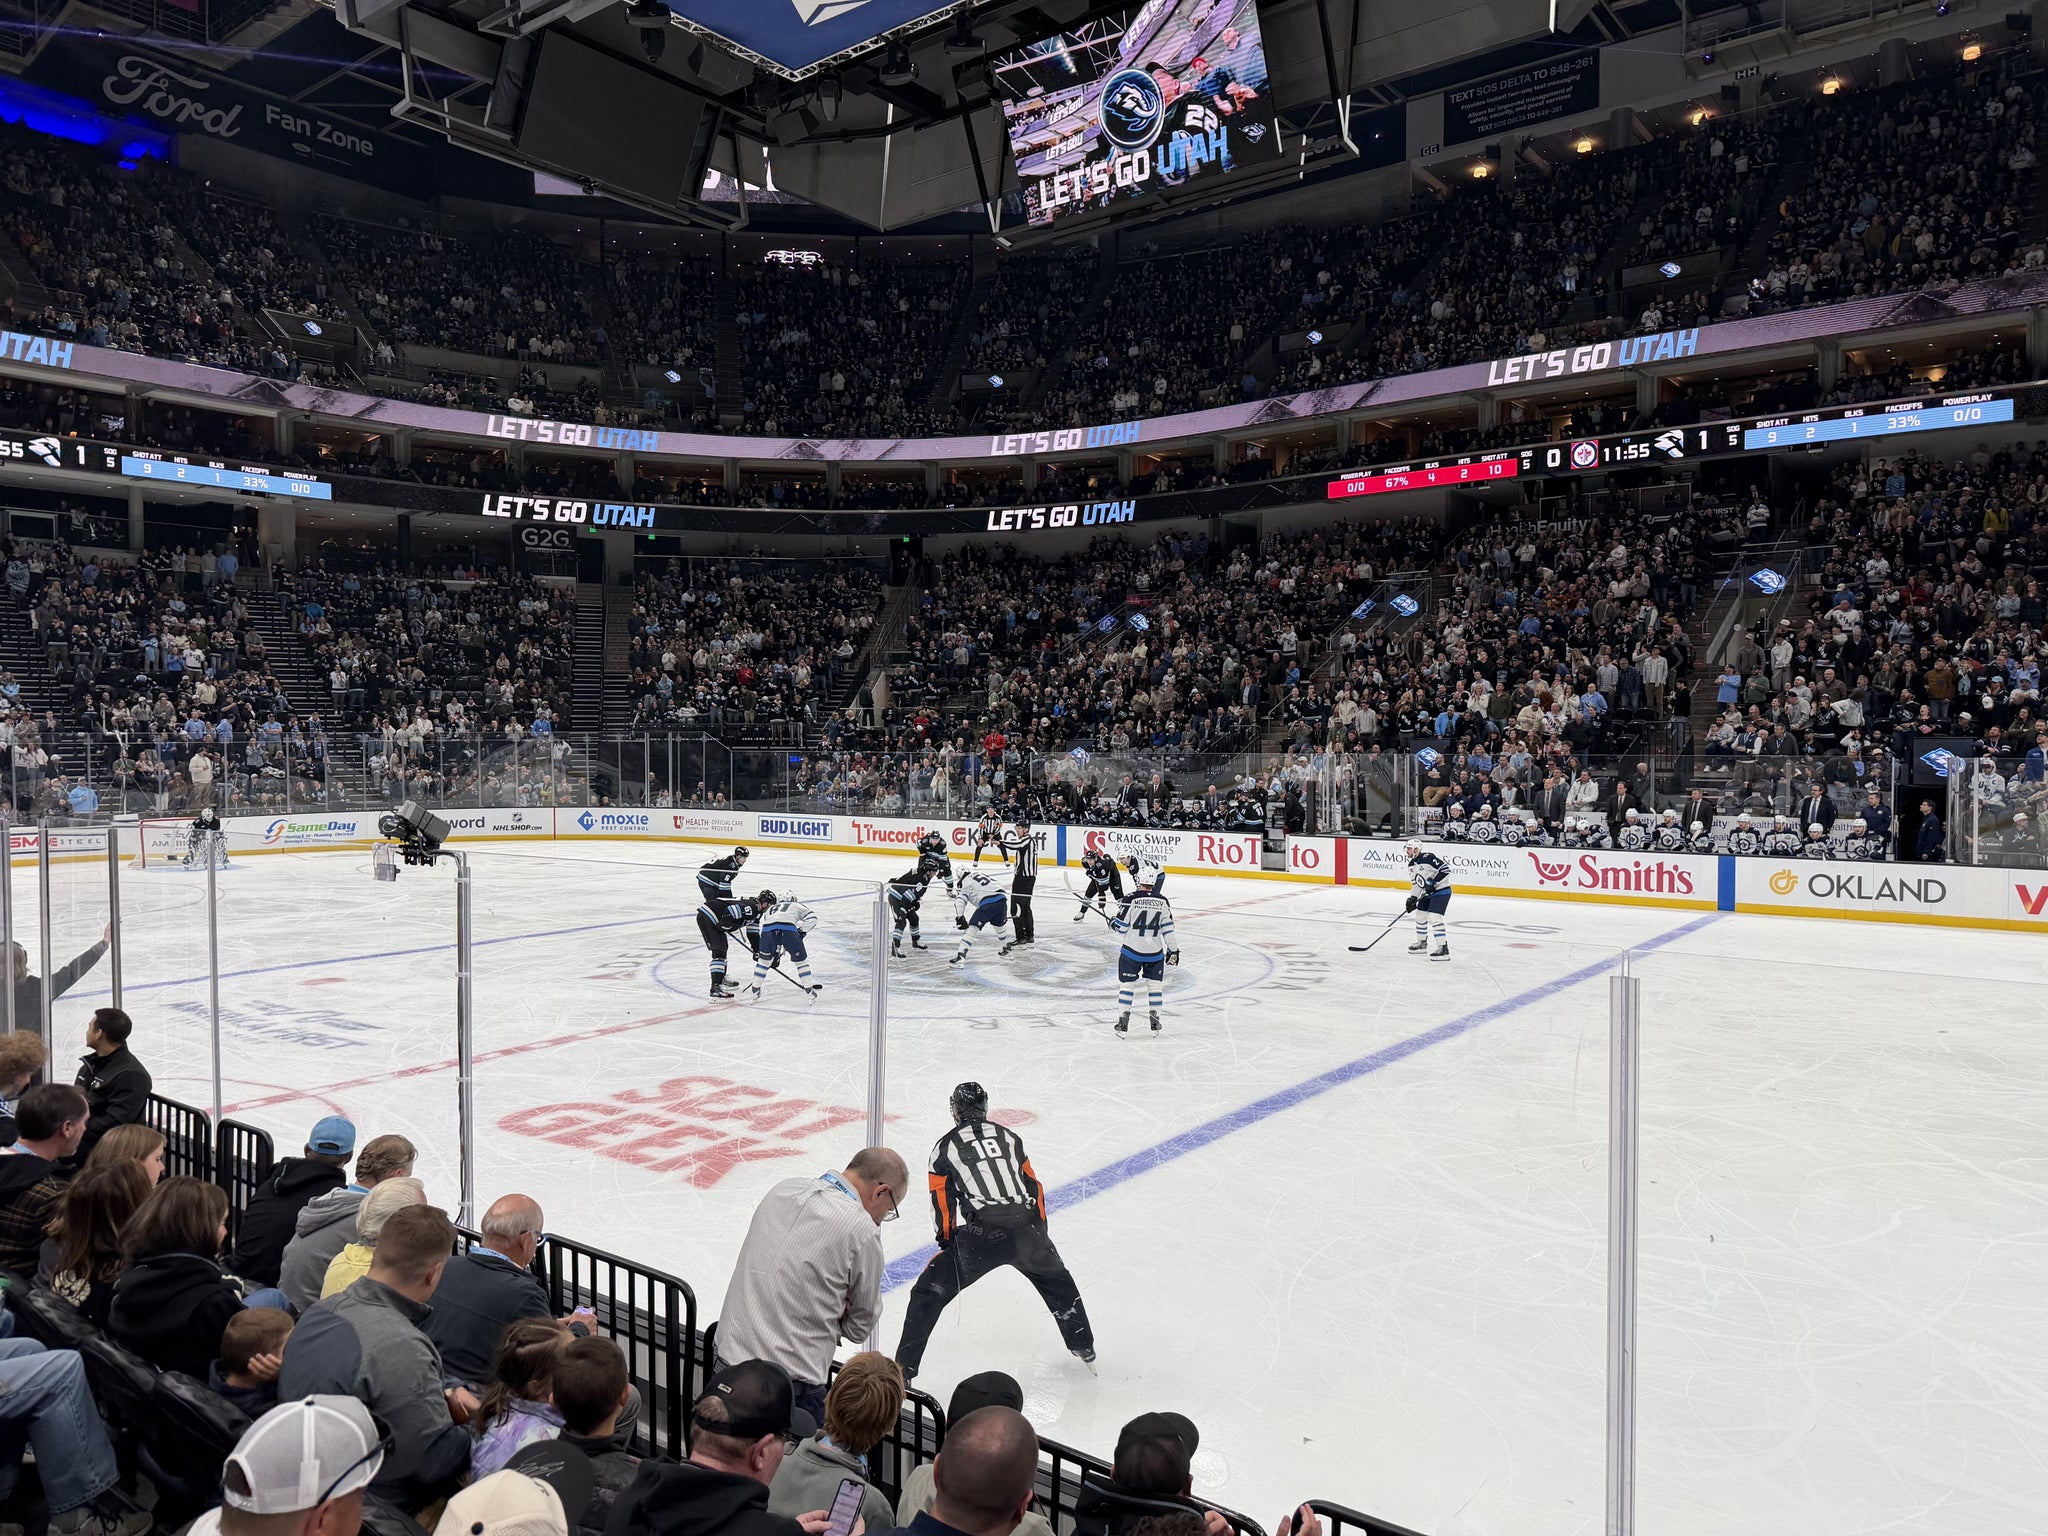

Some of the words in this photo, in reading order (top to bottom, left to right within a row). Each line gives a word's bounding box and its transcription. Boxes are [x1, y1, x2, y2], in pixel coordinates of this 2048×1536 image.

[1450, 89, 1475, 104] TEXT
[1476, 83, 1498, 97] SOS
[1500, 74, 1531, 90] DELTA
[1533, 69, 1548, 81] TO
[1550, 56, 1594, 77] 848-261
[103, 55, 244, 137] Ford
[1478, 123, 1493, 133] TEXT
[1507, 115, 1526, 125] DELTA
[1527, 112, 1536, 120] TO
[265, 103, 311, 136] Fan
[316, 120, 374, 156] Zone
[1040, 162, 1108, 209] LET'S
[1115, 150, 1150, 188] GO
[1158, 126, 1228, 175] UTAH
[1488, 348, 1566, 387] LET'S
[1571, 343, 1611, 374] GO
[1618, 328, 1699, 366] UTAH
[1943, 397, 1971, 407] POWER
[1971, 394, 1992, 403] PLAY
[1885, 402, 1923, 413] FACEOFFS
[1803, 414, 1818, 423] HITS
[1845, 409, 1863, 418] BLKS
[1954, 408, 1981, 422] 0/0
[1756, 420, 1776, 429] SHOT
[1776, 418, 1789, 427] ATT
[1851, 422, 1857, 433] 1
[1888, 415, 1921, 429] 33%
[487, 415, 555, 443] LET'S
[559, 423, 591, 446] GO
[597, 427, 658, 452] UTAH
[1726, 425, 1740, 433] SOG
[1806, 428, 1815, 438] 2
[991, 432, 1048, 456] LET'S
[1053, 428, 1082, 451] GO
[1087, 421, 1140, 448] UTAH
[1699, 430, 1708, 450] 1
[1729, 434, 1737, 446] 5
[1768, 432, 1777, 443] 9
[76, 445, 86, 465] 1
[132, 450, 149, 458] SHOT
[1481, 454, 1497, 462] SHOT
[1497, 452, 1508, 460] ATT
[1547, 449, 1561, 467] 0
[107, 457, 115, 467] 5
[174, 456, 188, 464] HITS
[209, 461, 225, 469] BLKS
[1458, 457, 1471, 465] HITS
[1522, 459, 1530, 470] 5
[143, 464, 152, 474] 9
[177, 468, 185, 478] 2
[241, 466, 269, 475] FACEOFFS
[1359, 470, 1372, 478] PLAY
[1384, 466, 1410, 474] FACEOFFS
[1460, 469, 1468, 478] 2
[1489, 464, 1502, 475] 10
[215, 473, 220, 483] 1
[243, 476, 268, 488] 33%
[302, 474, 317, 482] PLAY
[1386, 477, 1409, 488] 67%
[1428, 473, 1435, 482] 4
[291, 482, 310, 493] 0/0
[1347, 482, 1365, 493] 0/0
[482, 494, 549, 520] LET'S
[554, 501, 587, 524] GO
[593, 504, 655, 528] UTAH
[987, 507, 1045, 531] LET'S
[1050, 505, 1078, 528] GO
[1083, 500, 1136, 525] UTAH
[522, 528, 570, 547] G2G
[601, 814, 649, 825] moxie
[685, 818, 709, 826] HEALTH
[287, 821, 357, 833] SameDay
[761, 820, 788, 834] BUD
[790, 822, 829, 836] LIGHT
[863, 824, 930, 844] Trucordi
[1108, 832, 1141, 844] CRAIG
[1144, 833, 1181, 846] SWAPP
[60, 838, 102, 846] STEEL
[1452, 855, 1510, 869] COMPANY
[1362, 862, 1393, 870] INSURANCE
[1486, 870, 1510, 878] SURETY
[1578, 854, 1694, 895] Smith's
[1808, 873, 1947, 904] OKLAND
[1132, 910, 1162, 937] 44
[971, 1138, 1003, 1160] 18
